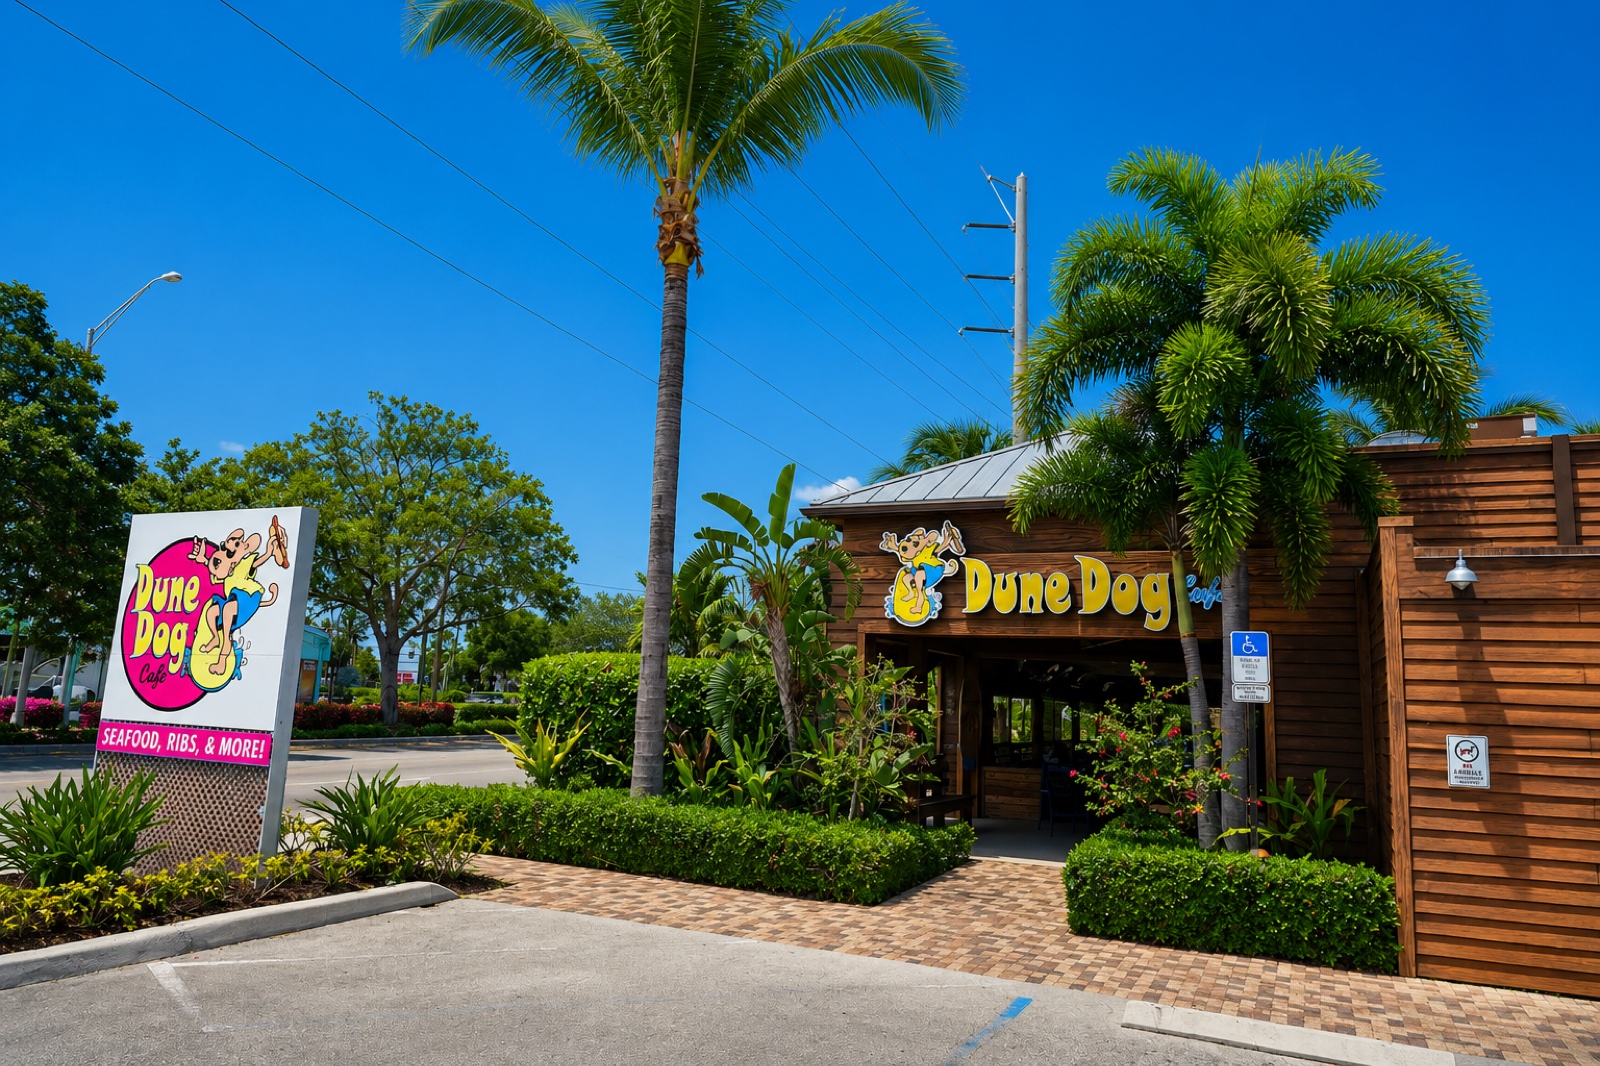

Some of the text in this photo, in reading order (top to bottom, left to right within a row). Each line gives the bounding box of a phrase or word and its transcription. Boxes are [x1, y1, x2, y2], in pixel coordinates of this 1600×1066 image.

[130, 564, 200, 613] Dune
[960, 555, 1071, 614] Dune
[1074, 555, 1171, 632] Dog
[129, 610, 189, 674] Dog
[139, 663, 167, 689] Cafe
[101, 727, 266, 759] SEAFOOD, RIBS, & MORE!
